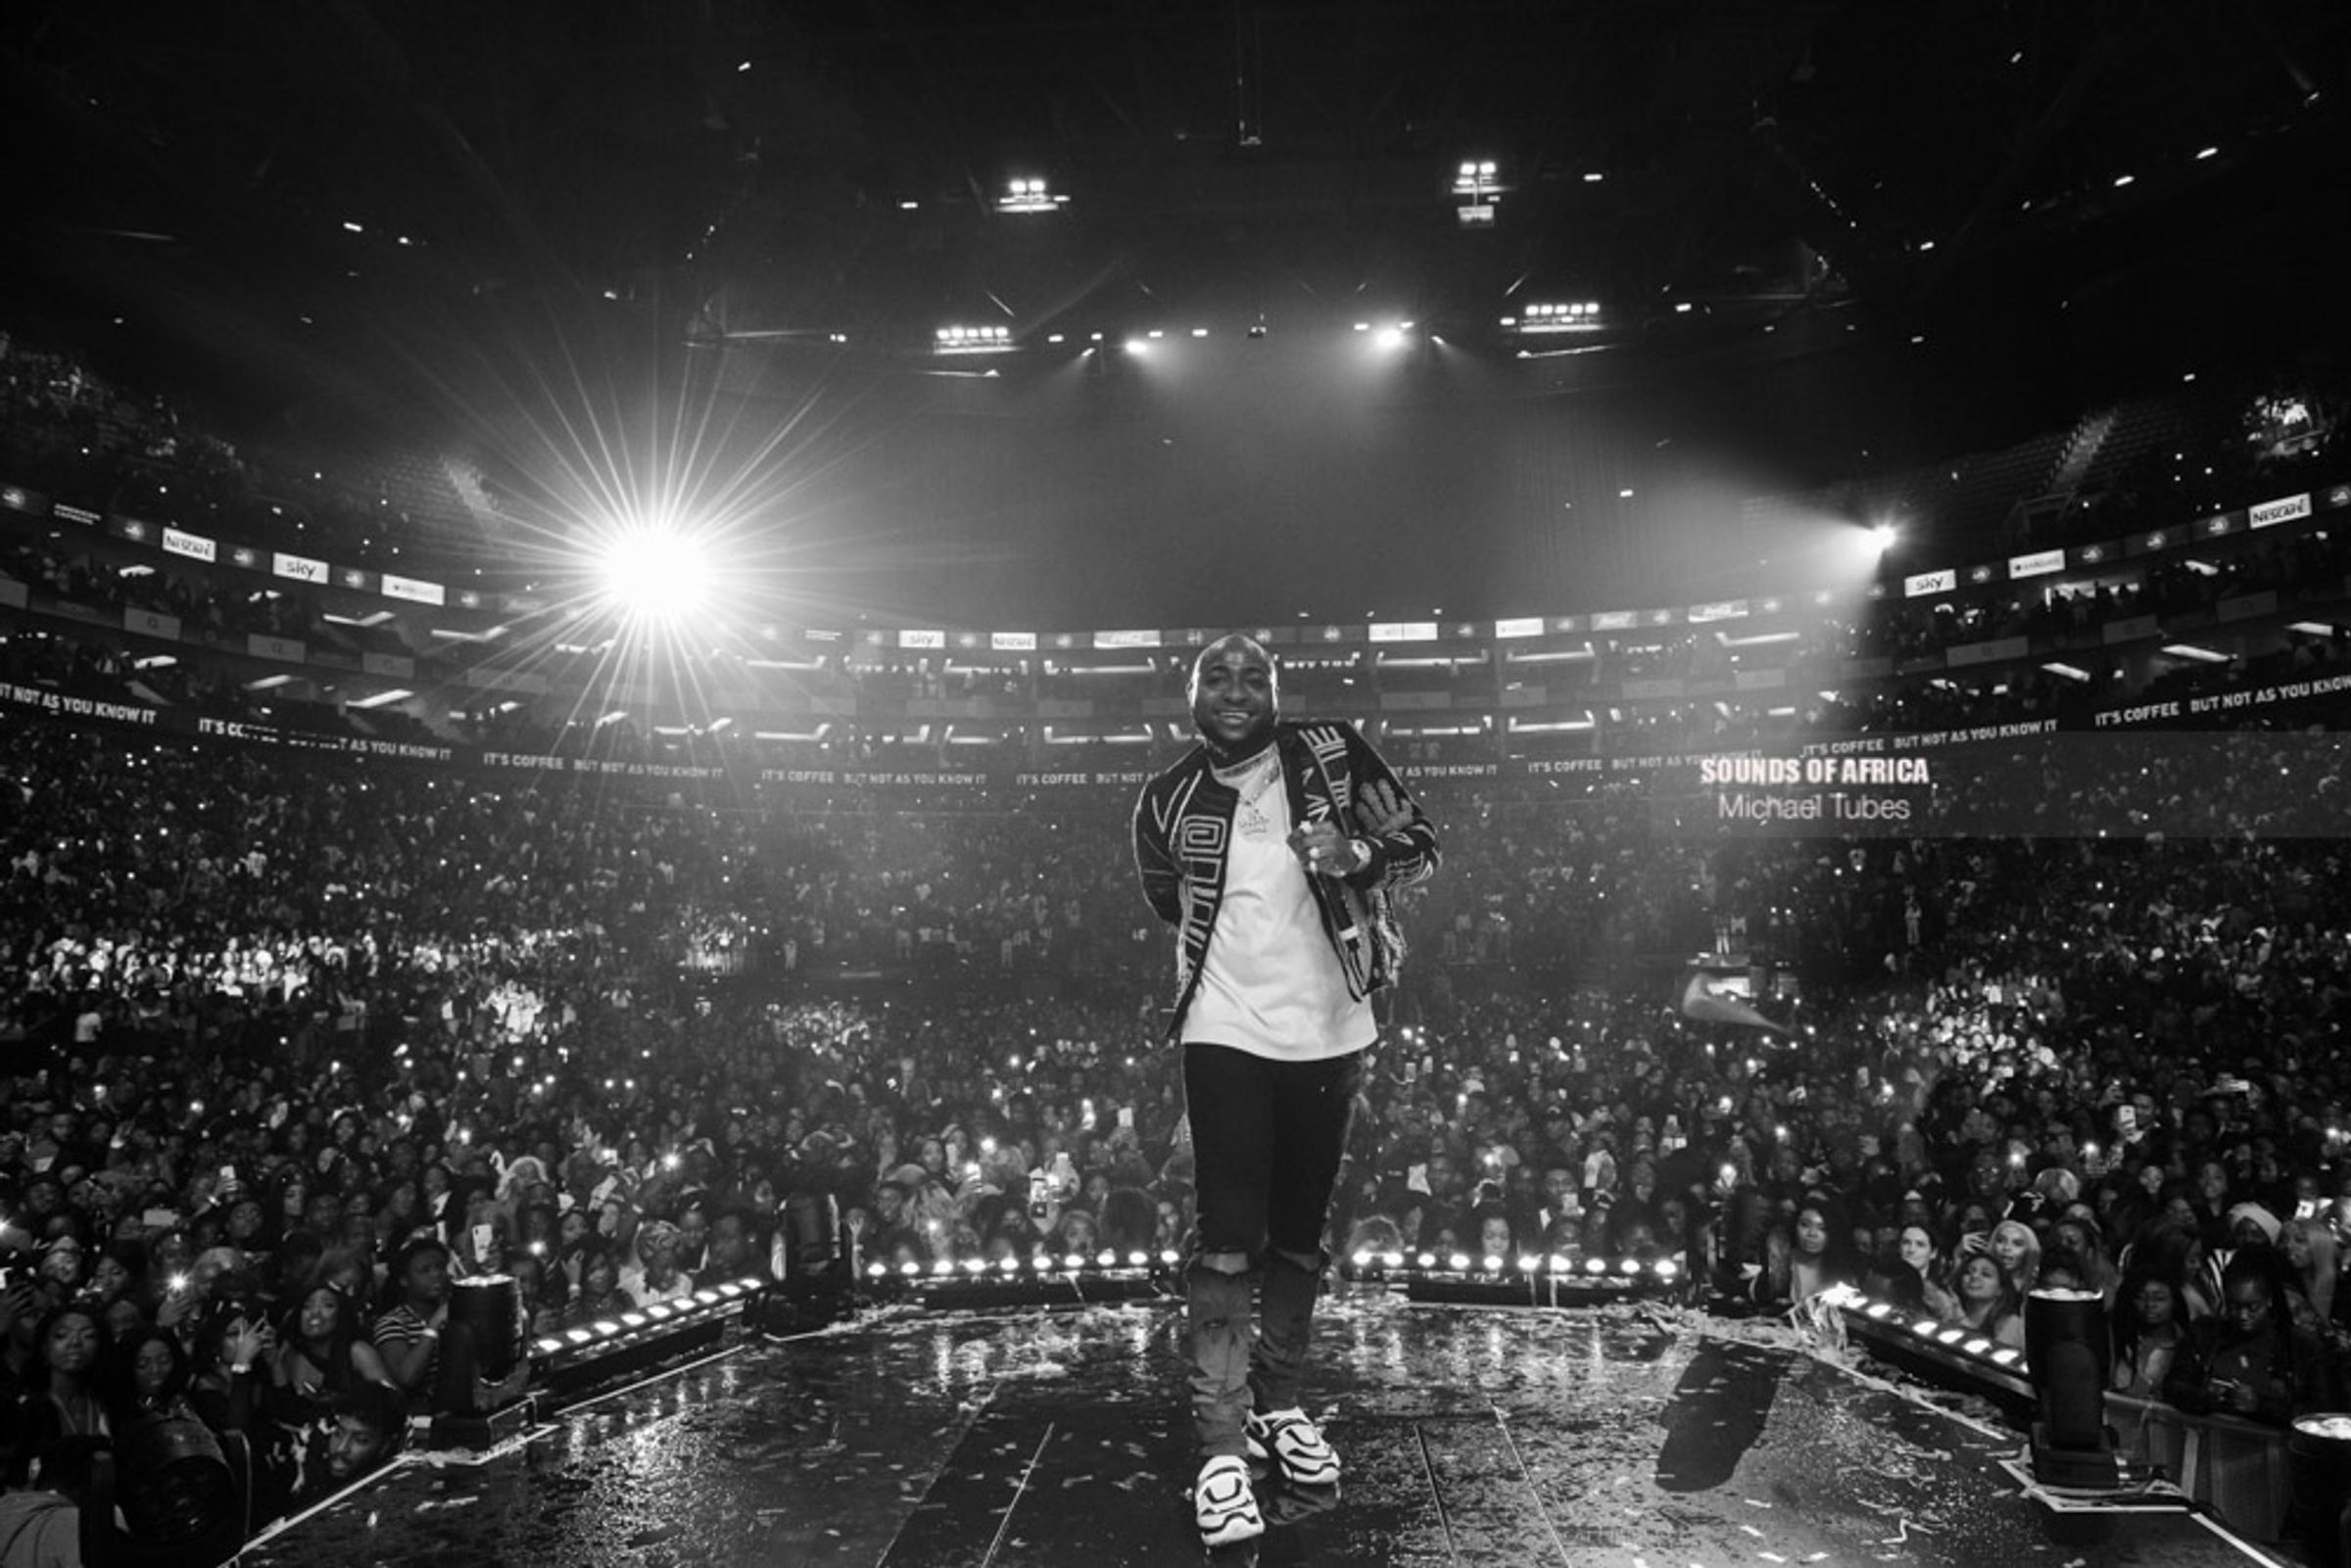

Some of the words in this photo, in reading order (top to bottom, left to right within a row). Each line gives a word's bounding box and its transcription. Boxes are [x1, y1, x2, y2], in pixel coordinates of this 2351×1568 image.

[14, 687, 41, 704] NOT
[41, 693, 60, 709] AS
[63, 696, 93, 715] YOU
[95, 702, 141, 723] KNOW
[142, 710, 157, 725] IT
[2094, 709, 2123, 727] IT'S
[2124, 700, 2182, 723] COFFEE
[2190, 695, 2221, 713] BUT
[2222, 691, 2252, 709] NOT
[2255, 688, 2278, 704] AS
[2279, 683, 2311, 699] YOU
[199, 718, 225, 735] IT'S
[350, 738, 368, 752] AS
[369, 740, 397, 755] YOU
[399, 743, 438, 759] KNOW
[439, 747, 453, 760] IT
[1831, 738, 1885, 754] COFFEE
[1894, 736, 1920, 749] BUT
[1921, 732, 1948, 747] NOT
[1949, 729, 1969, 742] AS
[1970, 726, 1997, 740] YOU
[1999, 721, 2042, 737] KNOW
[2043, 719, 2057, 733] IT
[484, 752, 509, 766] IT'S
[512, 754, 565, 771] COFFEE
[574, 759, 599, 773] BUT
[600, 761, 625, 773] NOT
[628, 763, 645, 775] AS
[646, 764, 669, 776] YOU
[671, 766, 709, 777] KNOW
[712, 768, 724, 778] IT
[761, 768, 785, 782] IT'S
[788, 770, 835, 784] COFFEE
[843, 772, 867, 784] BUT
[869, 773, 892, 784] NOT
[894, 773, 911, 784] AS
[913, 773, 937, 784] YOU
[938, 773, 973, 784] KNOW
[976, 773, 987, 784] IT
[1406, 765, 1421, 777] AS
[1423, 765, 1448, 778] YOU
[1449, 764, 1485, 776] KNOW
[1486, 763, 1498, 775] IT
[1528, 761, 1552, 773] IT'S
[1555, 759, 1604, 772] COFFEE
[1611, 758, 1637, 771] BUT
[1639, 756, 1662, 768] NOT
[1666, 754, 1682, 766] AS
[1016, 773, 1038, 785] IT'S
[1041, 773, 1088, 785] COFFEE
[1095, 773, 1118, 784] BUT
[1121, 773, 1144, 784] NOT
